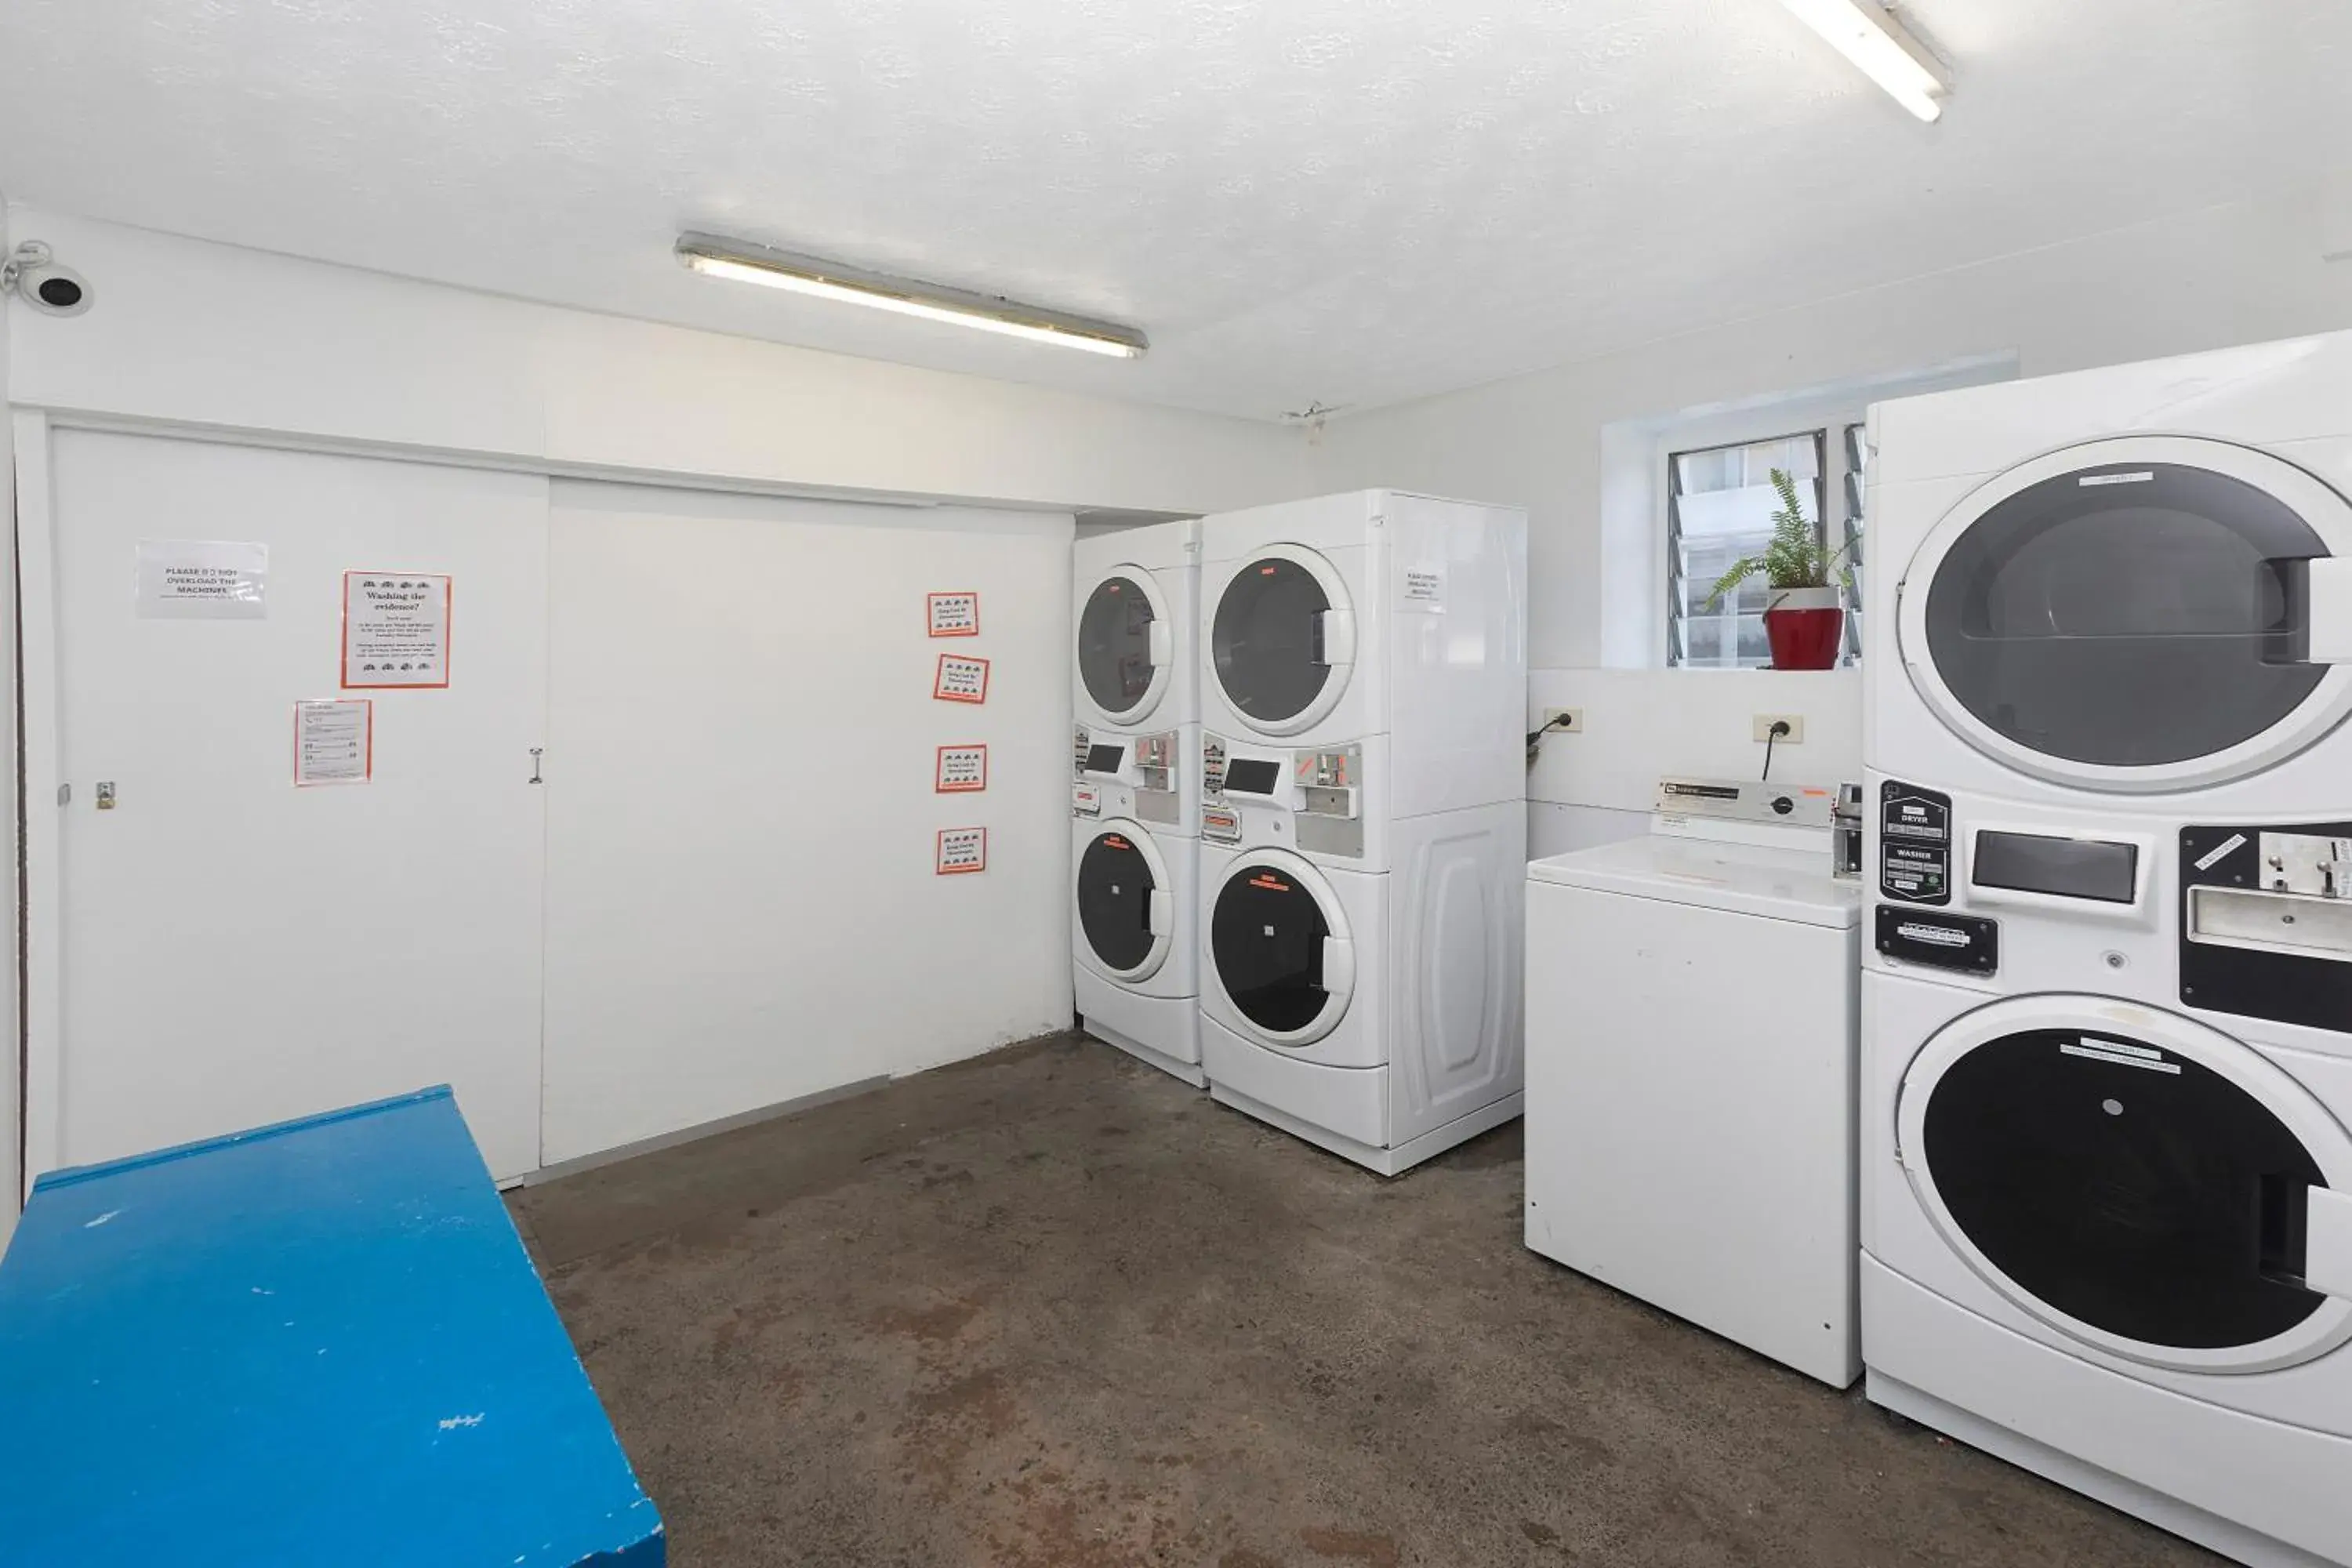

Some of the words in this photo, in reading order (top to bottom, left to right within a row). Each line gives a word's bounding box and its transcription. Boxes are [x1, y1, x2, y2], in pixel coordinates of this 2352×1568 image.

[365, 591, 408, 601] Washing
[410, 592, 426, 601] the
[374, 602, 419, 611] evidence?
[1901, 815, 1928, 824] DRYER
[1896, 849, 1932, 859] WASHER
